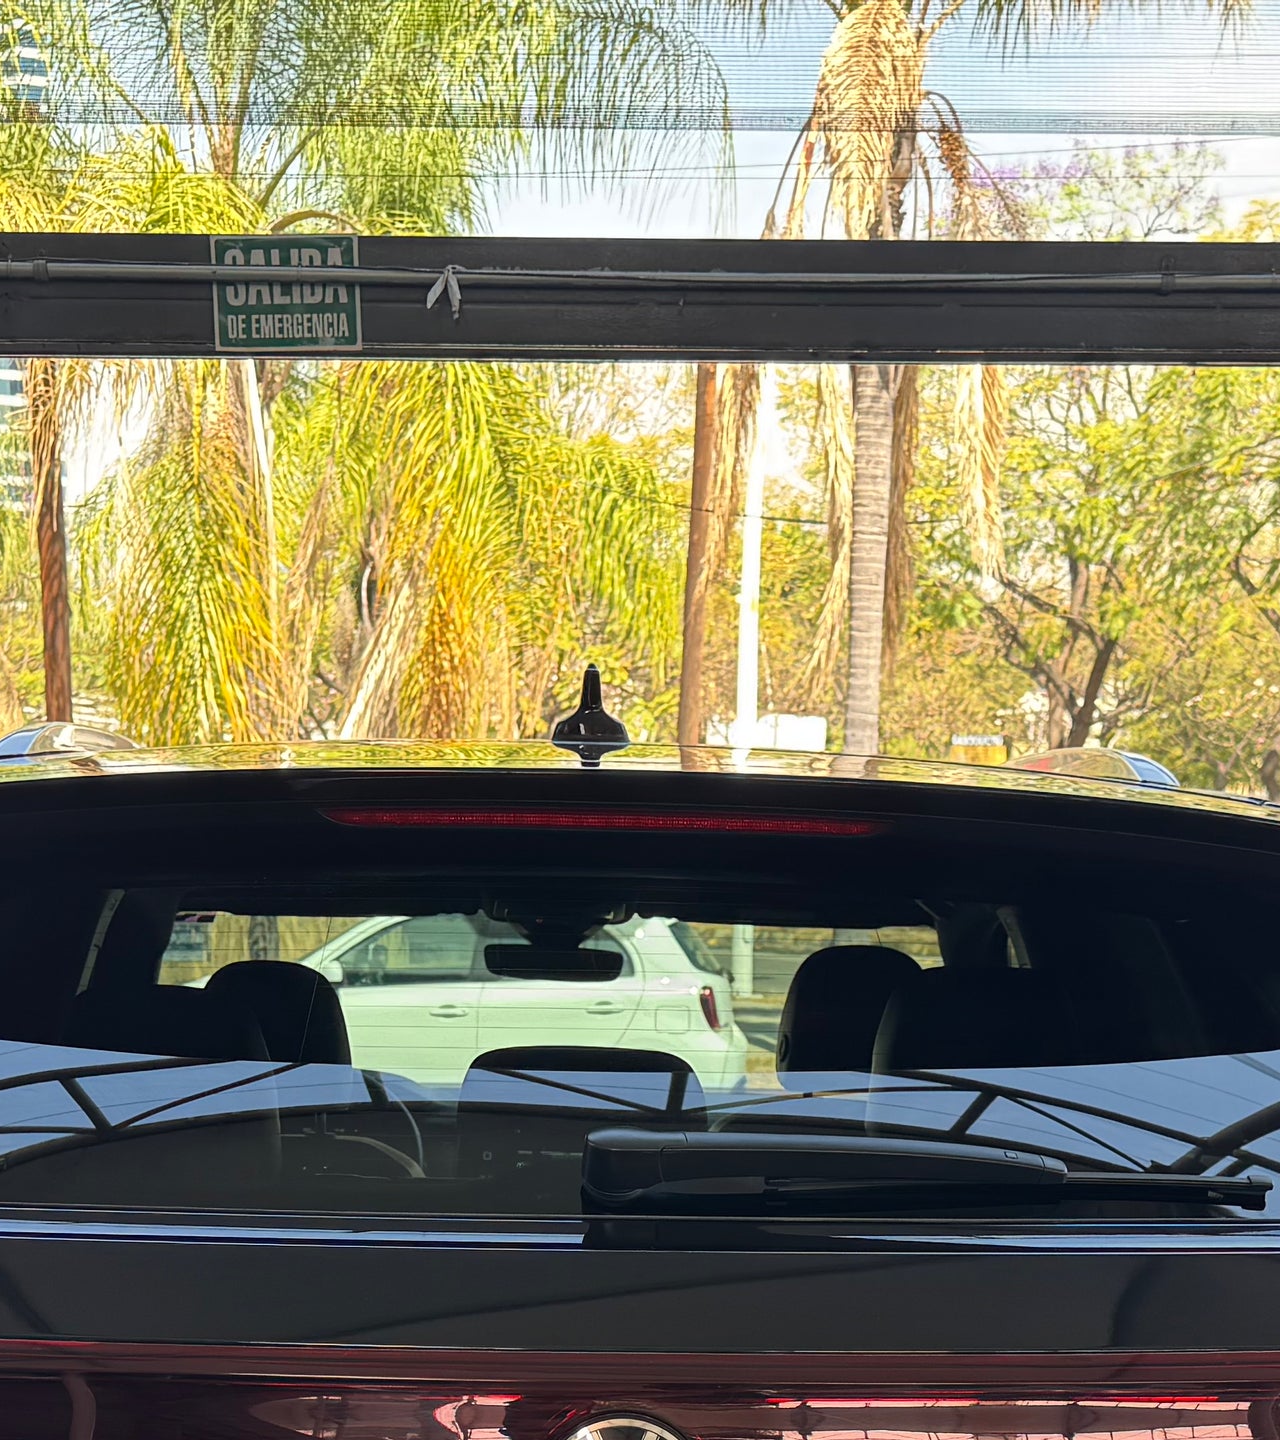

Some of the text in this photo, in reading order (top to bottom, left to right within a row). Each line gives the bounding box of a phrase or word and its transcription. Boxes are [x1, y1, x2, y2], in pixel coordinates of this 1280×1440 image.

[224, 247, 348, 306] SALIDA
[228, 312, 349, 339] DE EMERGENCIA
